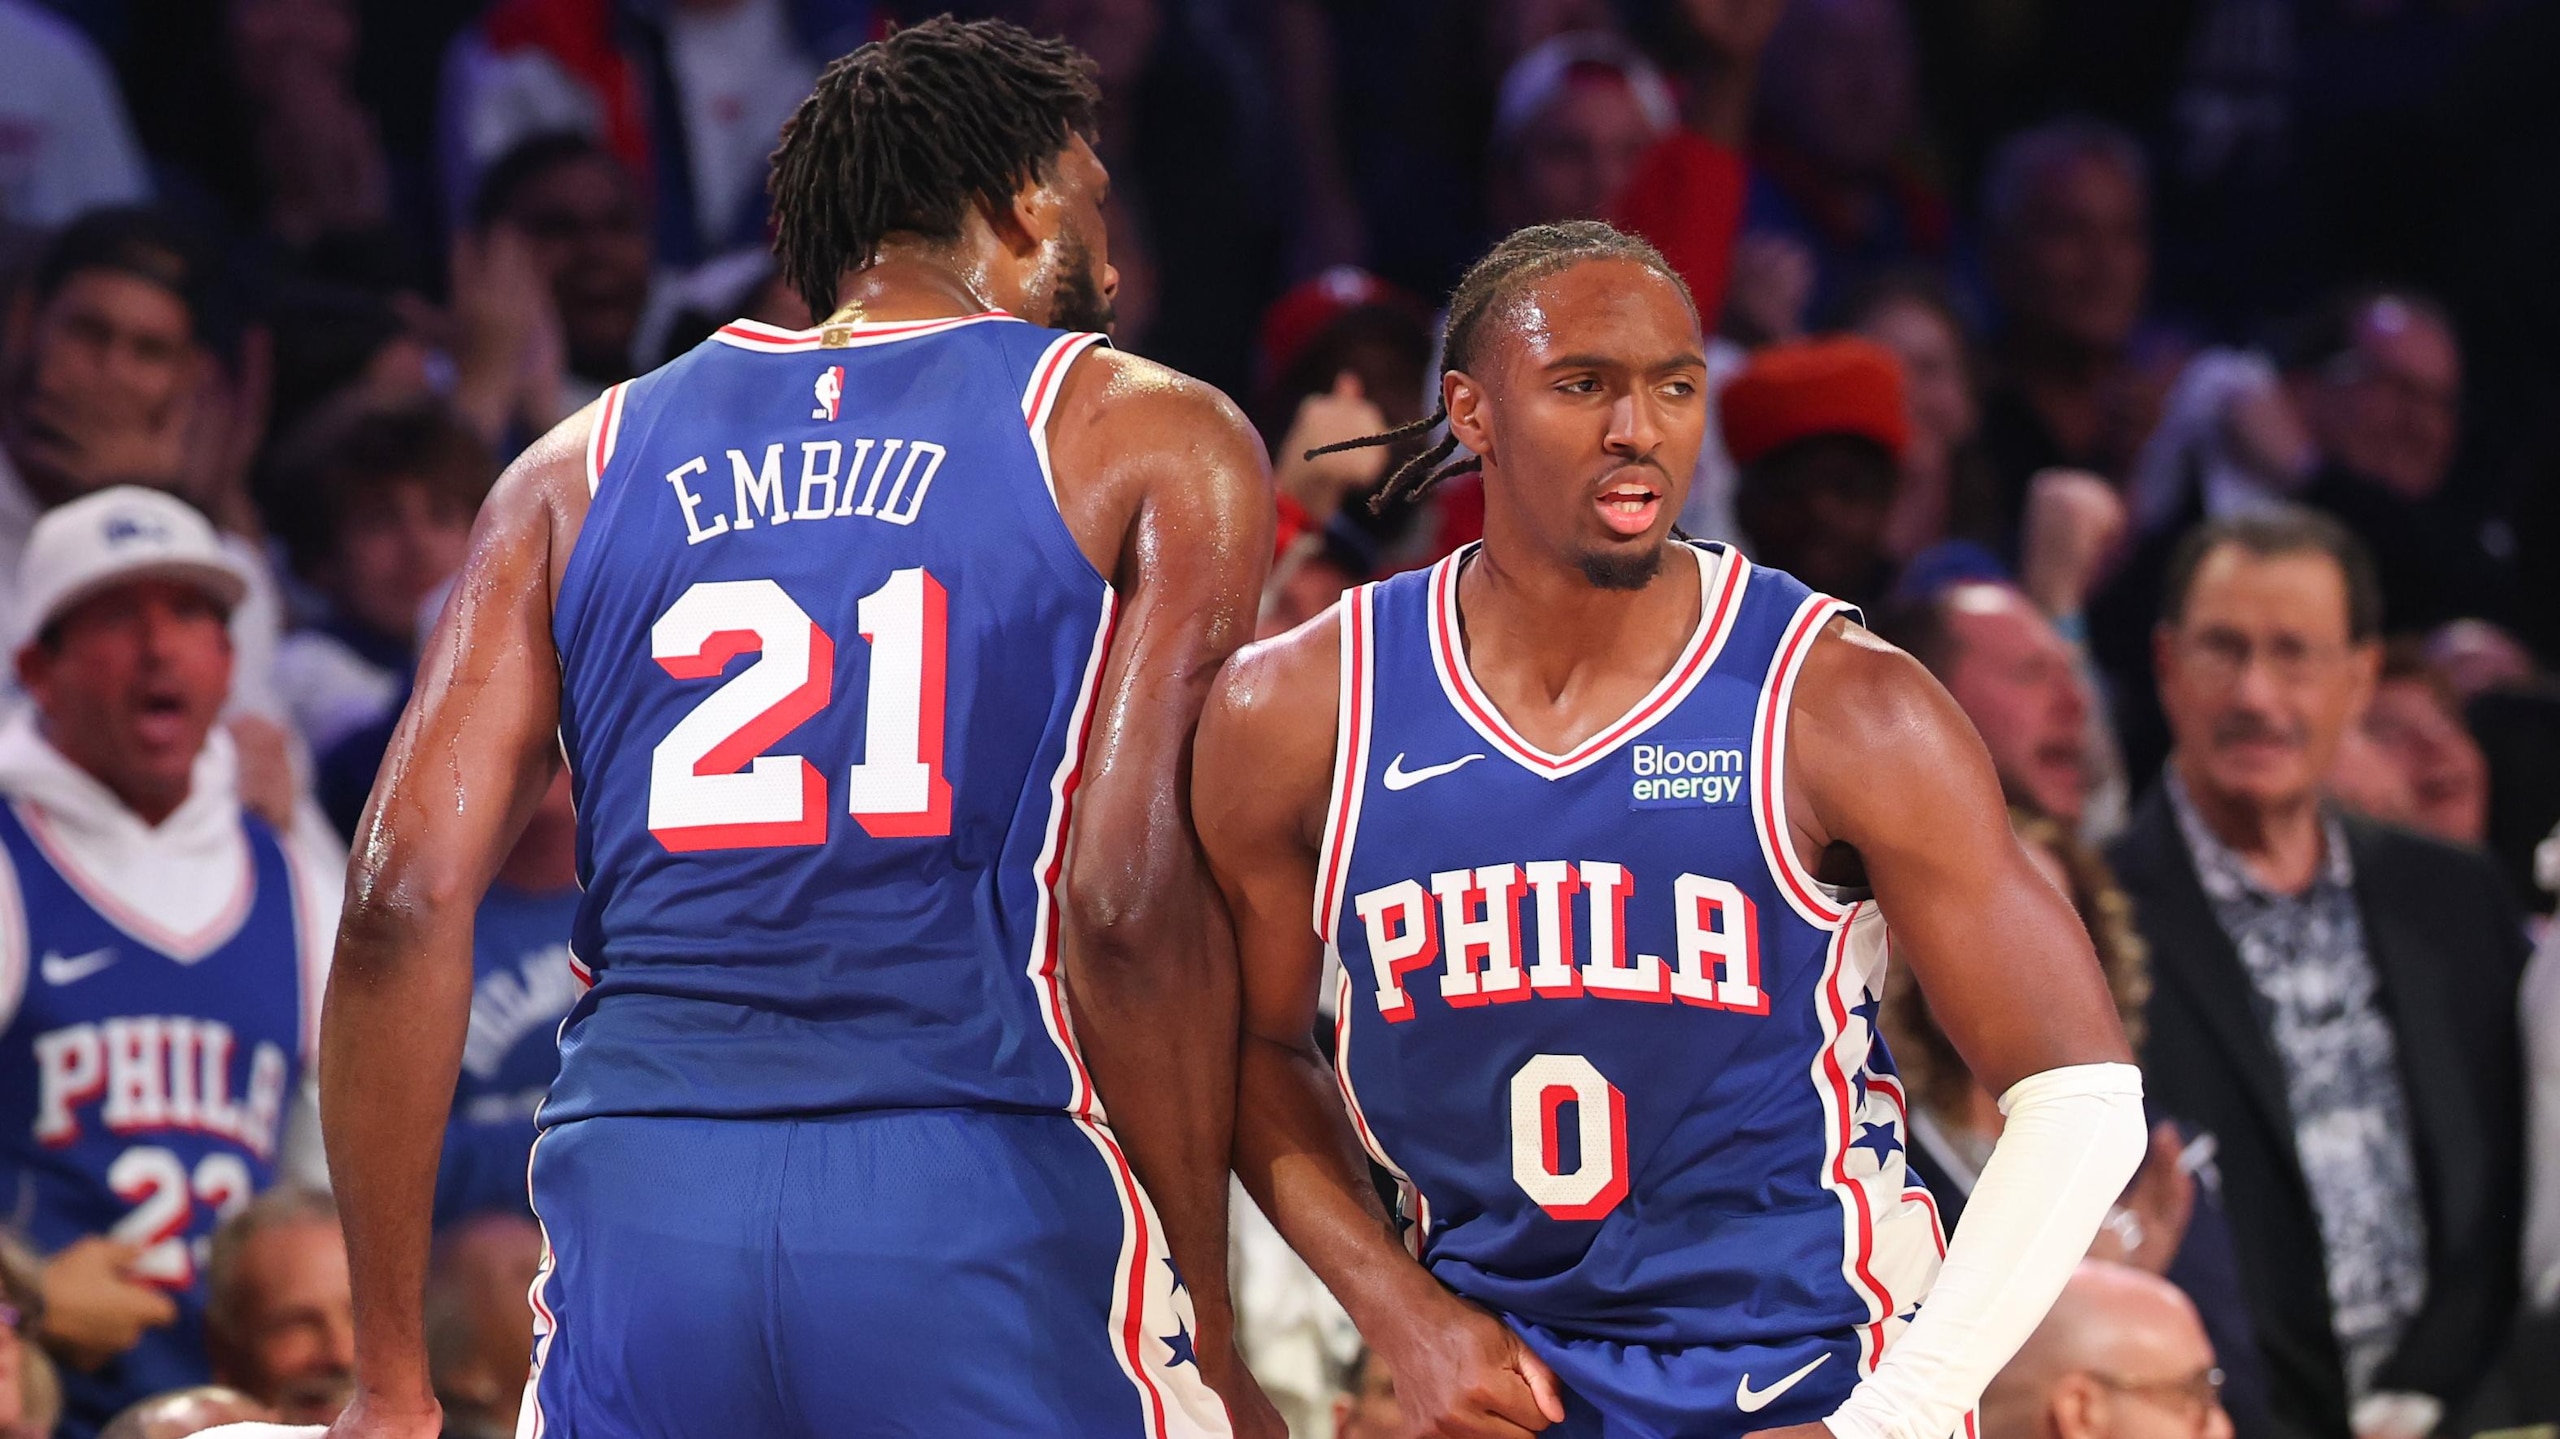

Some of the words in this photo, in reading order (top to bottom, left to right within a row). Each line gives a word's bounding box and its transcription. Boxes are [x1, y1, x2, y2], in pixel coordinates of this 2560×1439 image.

[666, 439, 946, 545] EMBIID
[647, 566, 952, 853] 21
[1633, 745, 1743, 776] Bloom
[1633, 776, 1743, 803] energy
[1355, 860, 1770, 1023] PHILA
[1511, 1054, 1628, 1221] 0
